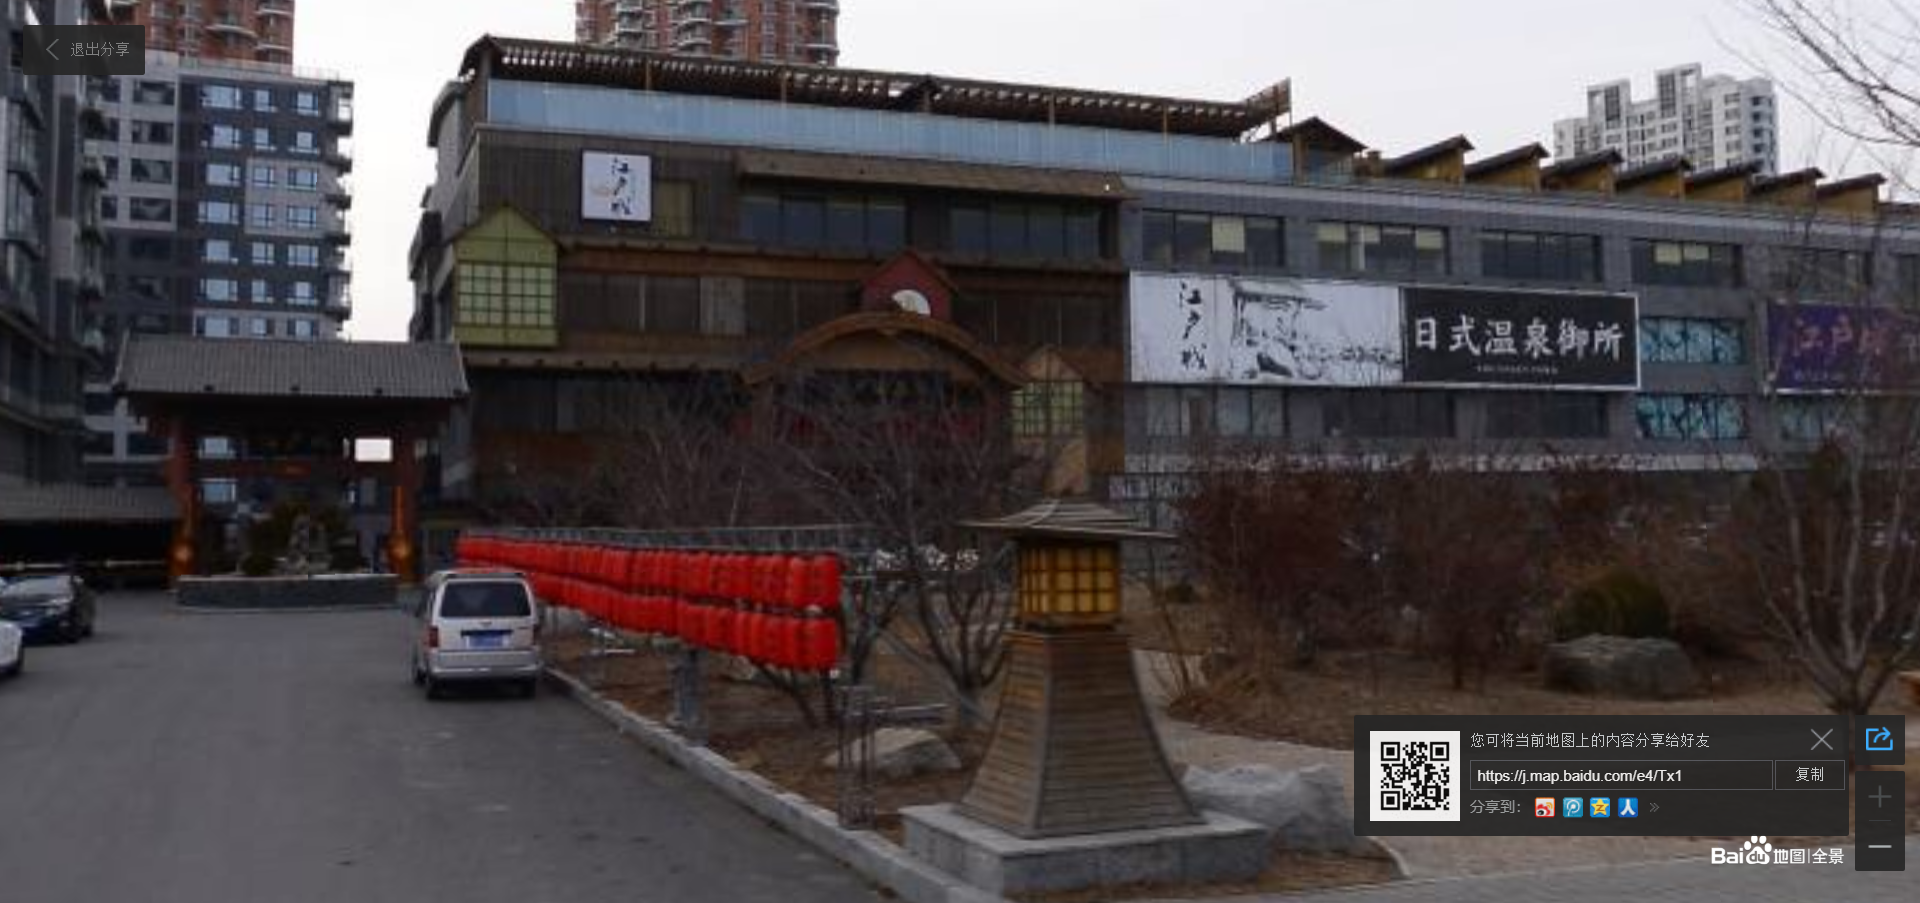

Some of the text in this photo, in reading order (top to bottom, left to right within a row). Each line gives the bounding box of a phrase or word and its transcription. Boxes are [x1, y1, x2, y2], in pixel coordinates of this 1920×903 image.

[1415, 313, 1625, 361] 日式温泉御所
